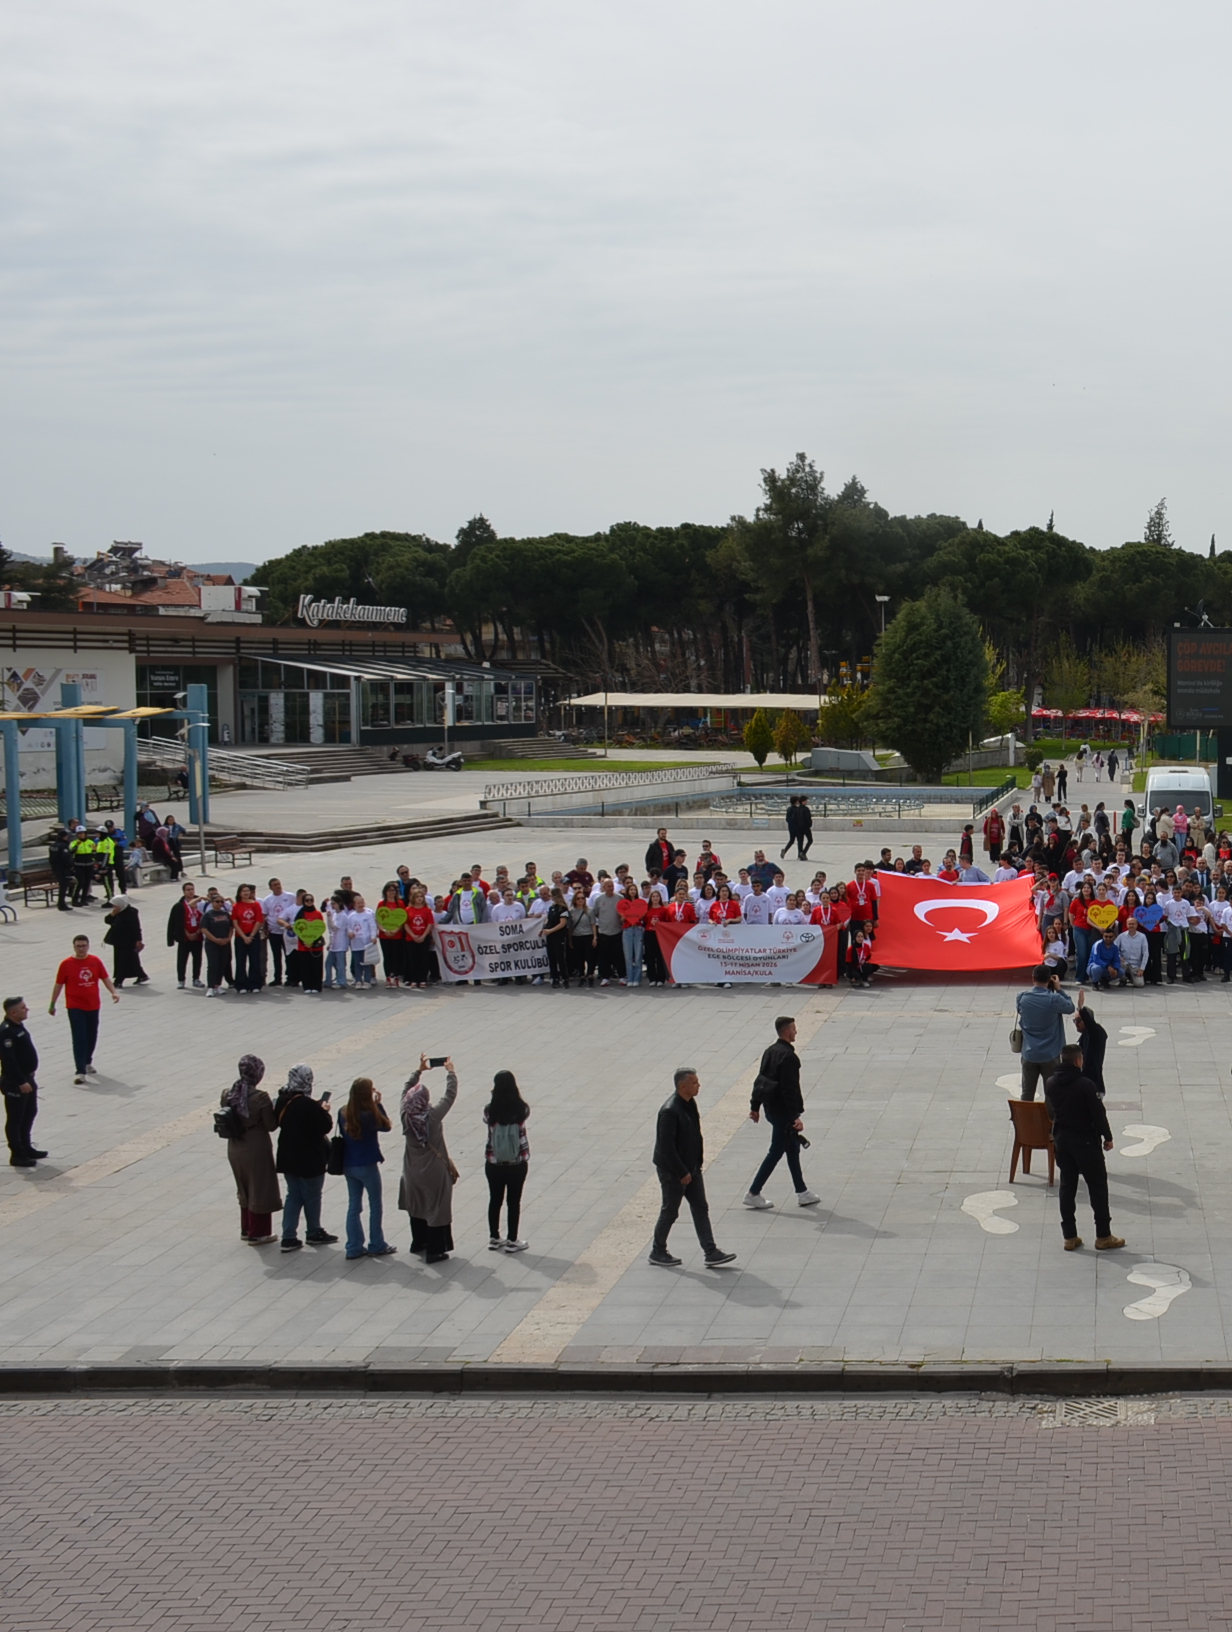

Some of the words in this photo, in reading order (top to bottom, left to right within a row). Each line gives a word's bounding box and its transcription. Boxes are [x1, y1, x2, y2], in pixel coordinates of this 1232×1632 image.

[298, 594, 408, 627] Katakekaumene
[1177, 639, 1198, 657] ÇÖP
[1177, 656, 1226, 672] GÖREVDE!
[499, 923, 525, 937] SOMA
[477, 944, 500, 956] ÖZEL
[501, 939, 547, 954] SPORCULA
[716, 946, 767, 954] OLİMPİYATLAR
[768, 946, 798, 954] TÜRKİYE
[488, 961, 513, 973] SPOR
[514, 955, 549, 970] KULÜBÜ
[724, 968, 773, 977] MANİSA/KULA
